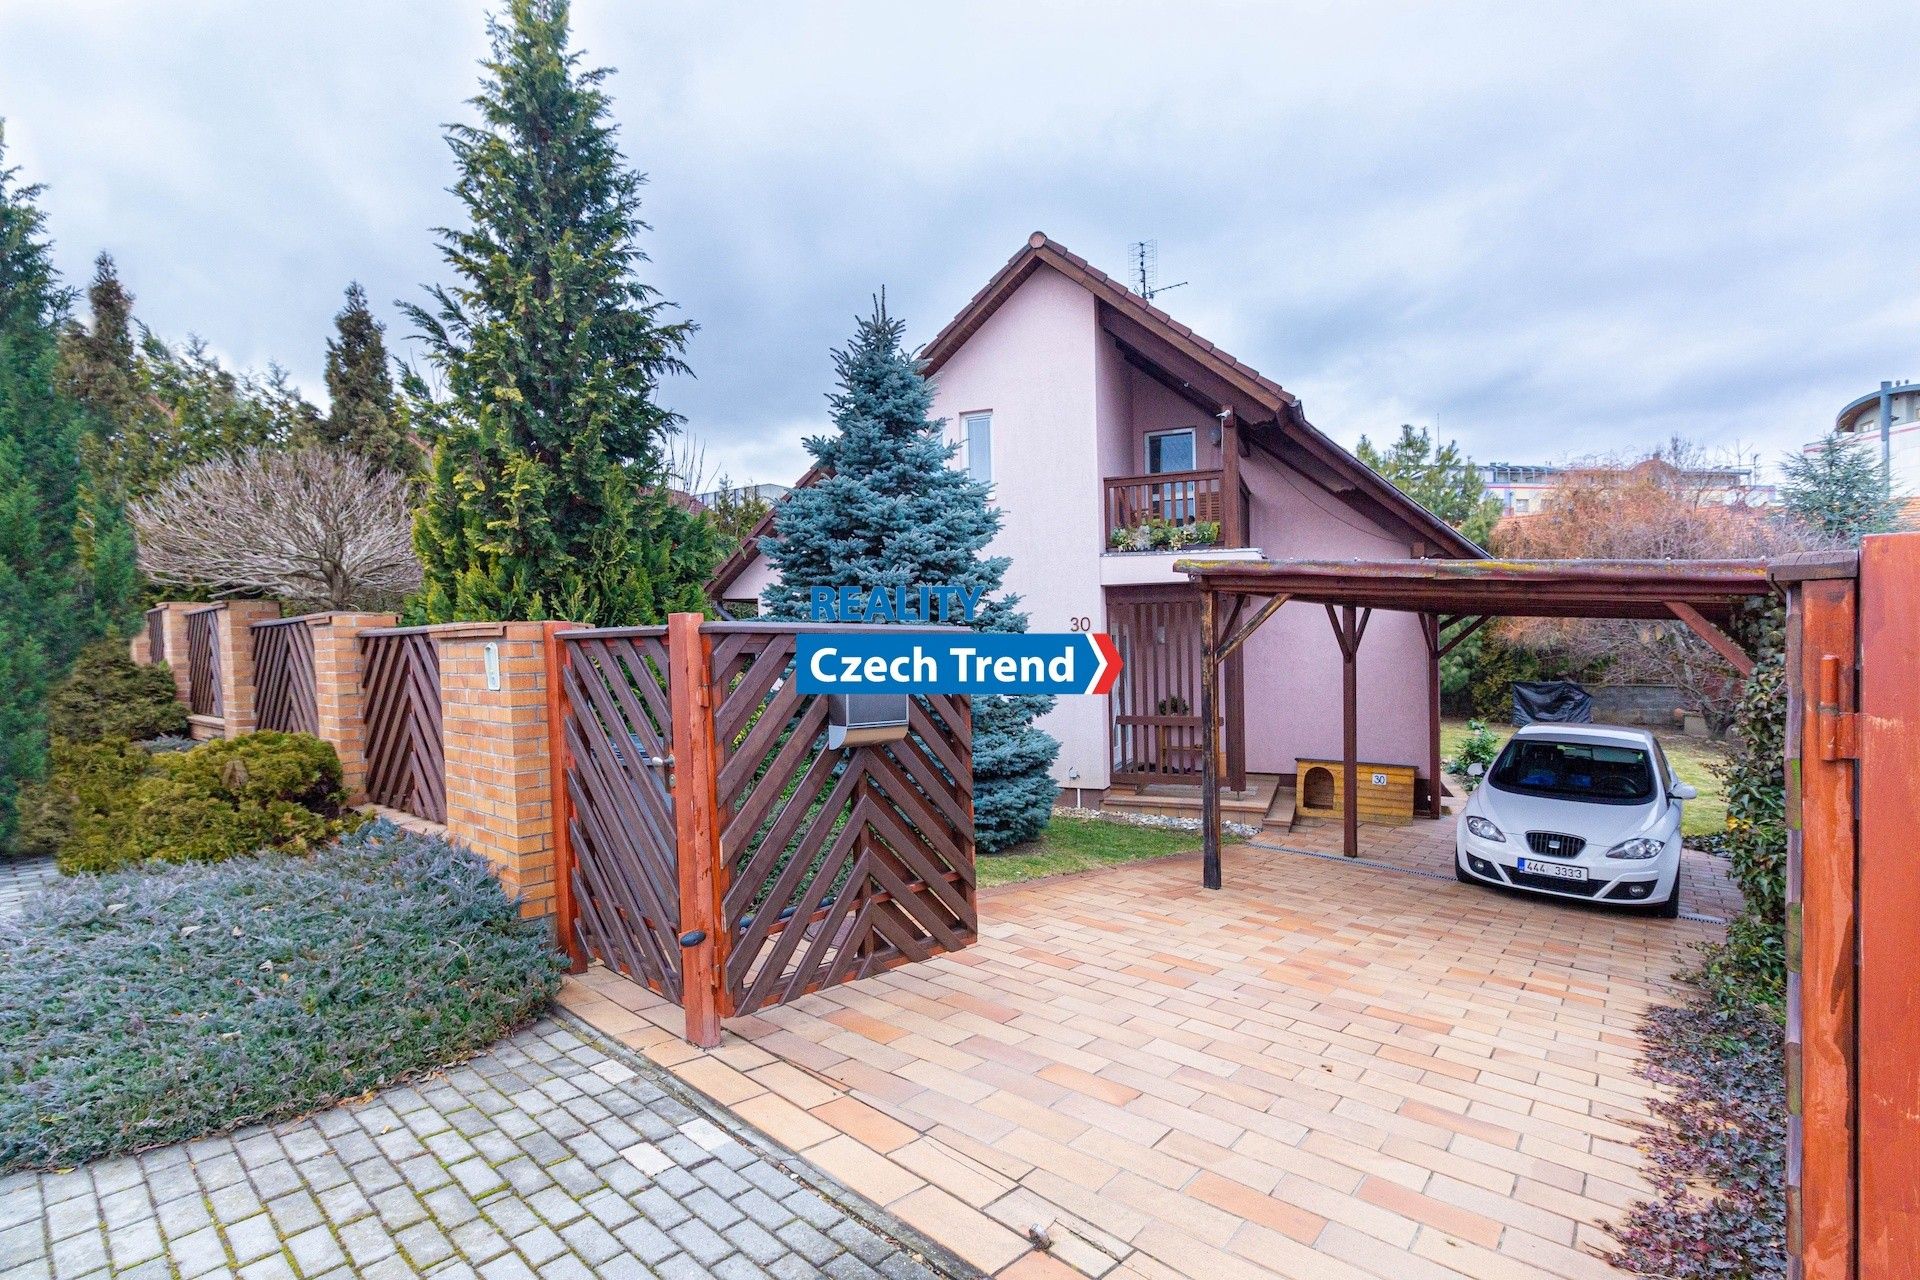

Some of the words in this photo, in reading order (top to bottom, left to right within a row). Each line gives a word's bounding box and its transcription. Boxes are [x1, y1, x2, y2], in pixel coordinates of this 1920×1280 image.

[1070, 616, 1091, 632] 30
[1373, 775, 1386, 785] 30
[1527, 861, 1545, 873] 444
[1555, 866, 1582, 879] 3333
